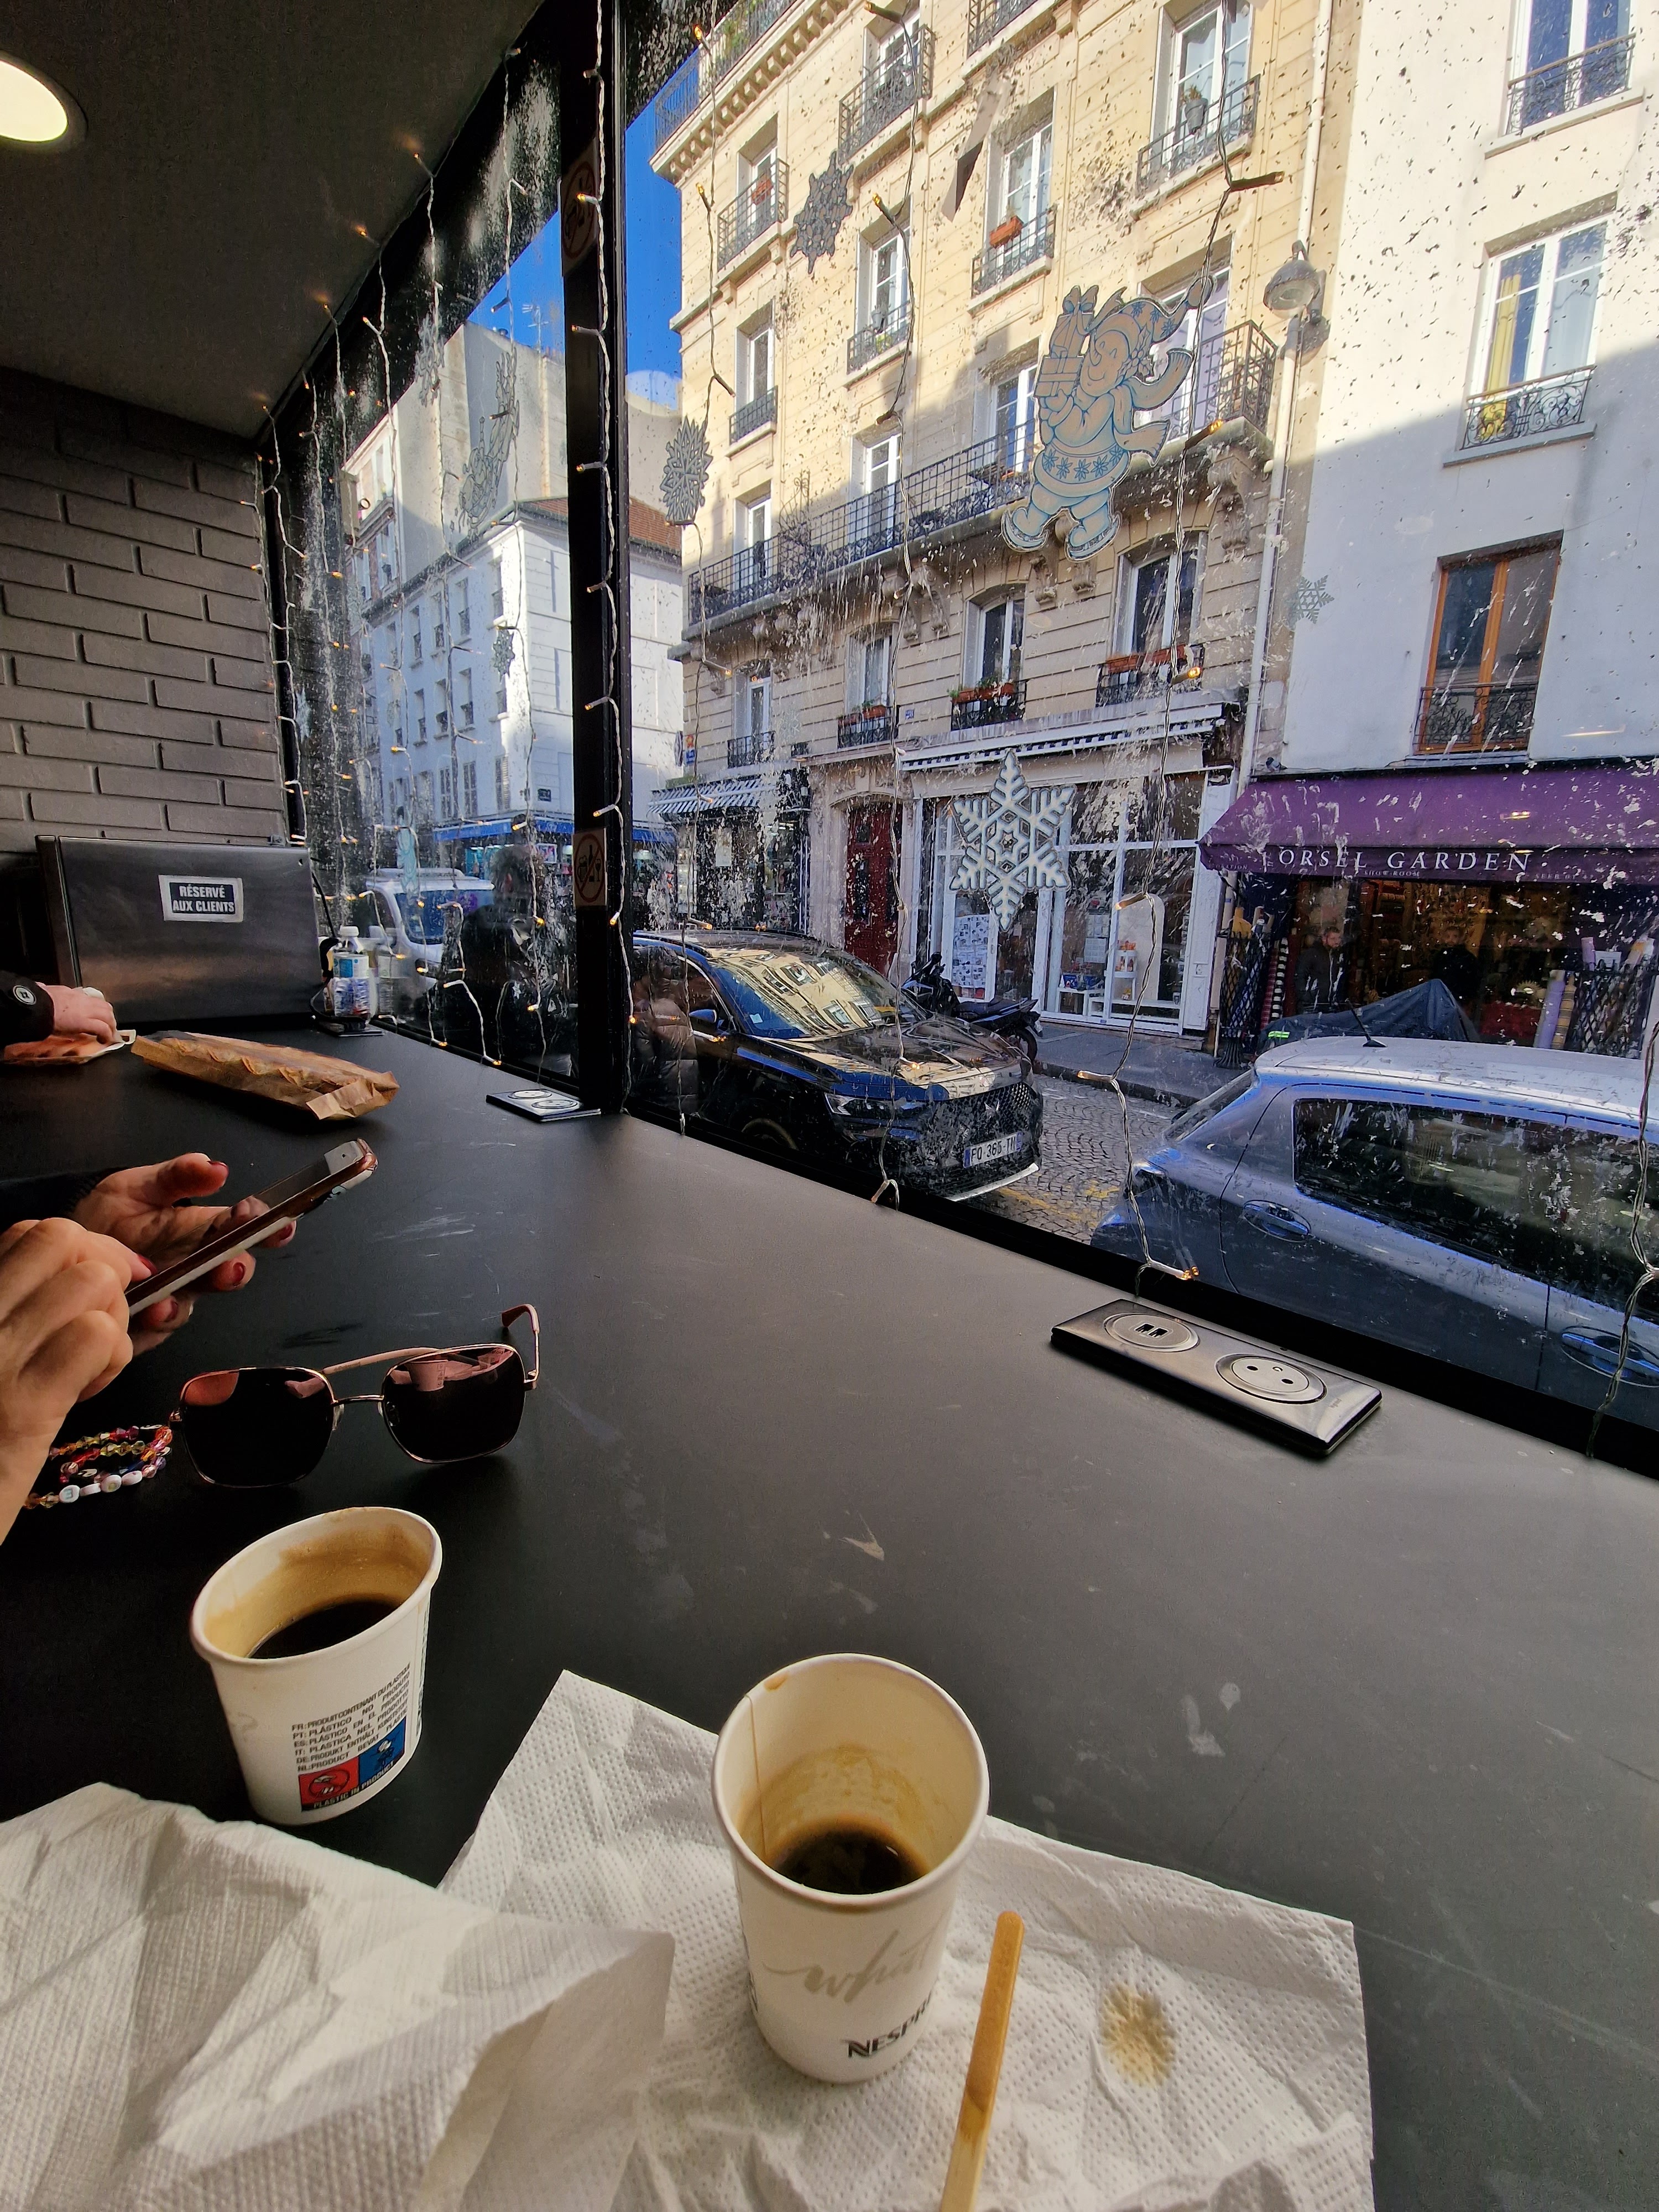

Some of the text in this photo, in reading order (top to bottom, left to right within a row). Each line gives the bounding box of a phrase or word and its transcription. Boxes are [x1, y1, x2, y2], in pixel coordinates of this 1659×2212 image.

[1279, 849, 1530, 871] ORSEL GARDEN
[173, 899, 235, 912] AUX CLIENTS
[179, 884, 225, 898] RÉSERVÉ
[307, 1714, 338, 1729] PRODUIT
[338, 1692, 377, 1719] CONTENANT
[378, 1686, 386, 1697] DU
[353, 1718, 363, 1729] EN
[368, 1711, 376, 1720] EL
[381, 1680, 409, 1712] PRODUCTO
[362, 1704, 374, 1715] NO
[382, 1671, 410, 1702] PRODUTO
[309, 1734, 352, 1754] PLASTICA
[357, 1723, 373, 1735] NEL
[377, 1688, 409, 1723] PRODOTTO
[310, 1746, 343, 1761] PRODUKT
[378, 1697, 408, 1730] KUNSTSTOFF
[311, 1751, 349, 1769] PRODUCT
[357, 1734, 379, 1752] BEVAT
[386, 1705, 408, 1732] PLASTIC
[313, 1760, 394, 1809] PLASTIC IN PRODUCT
